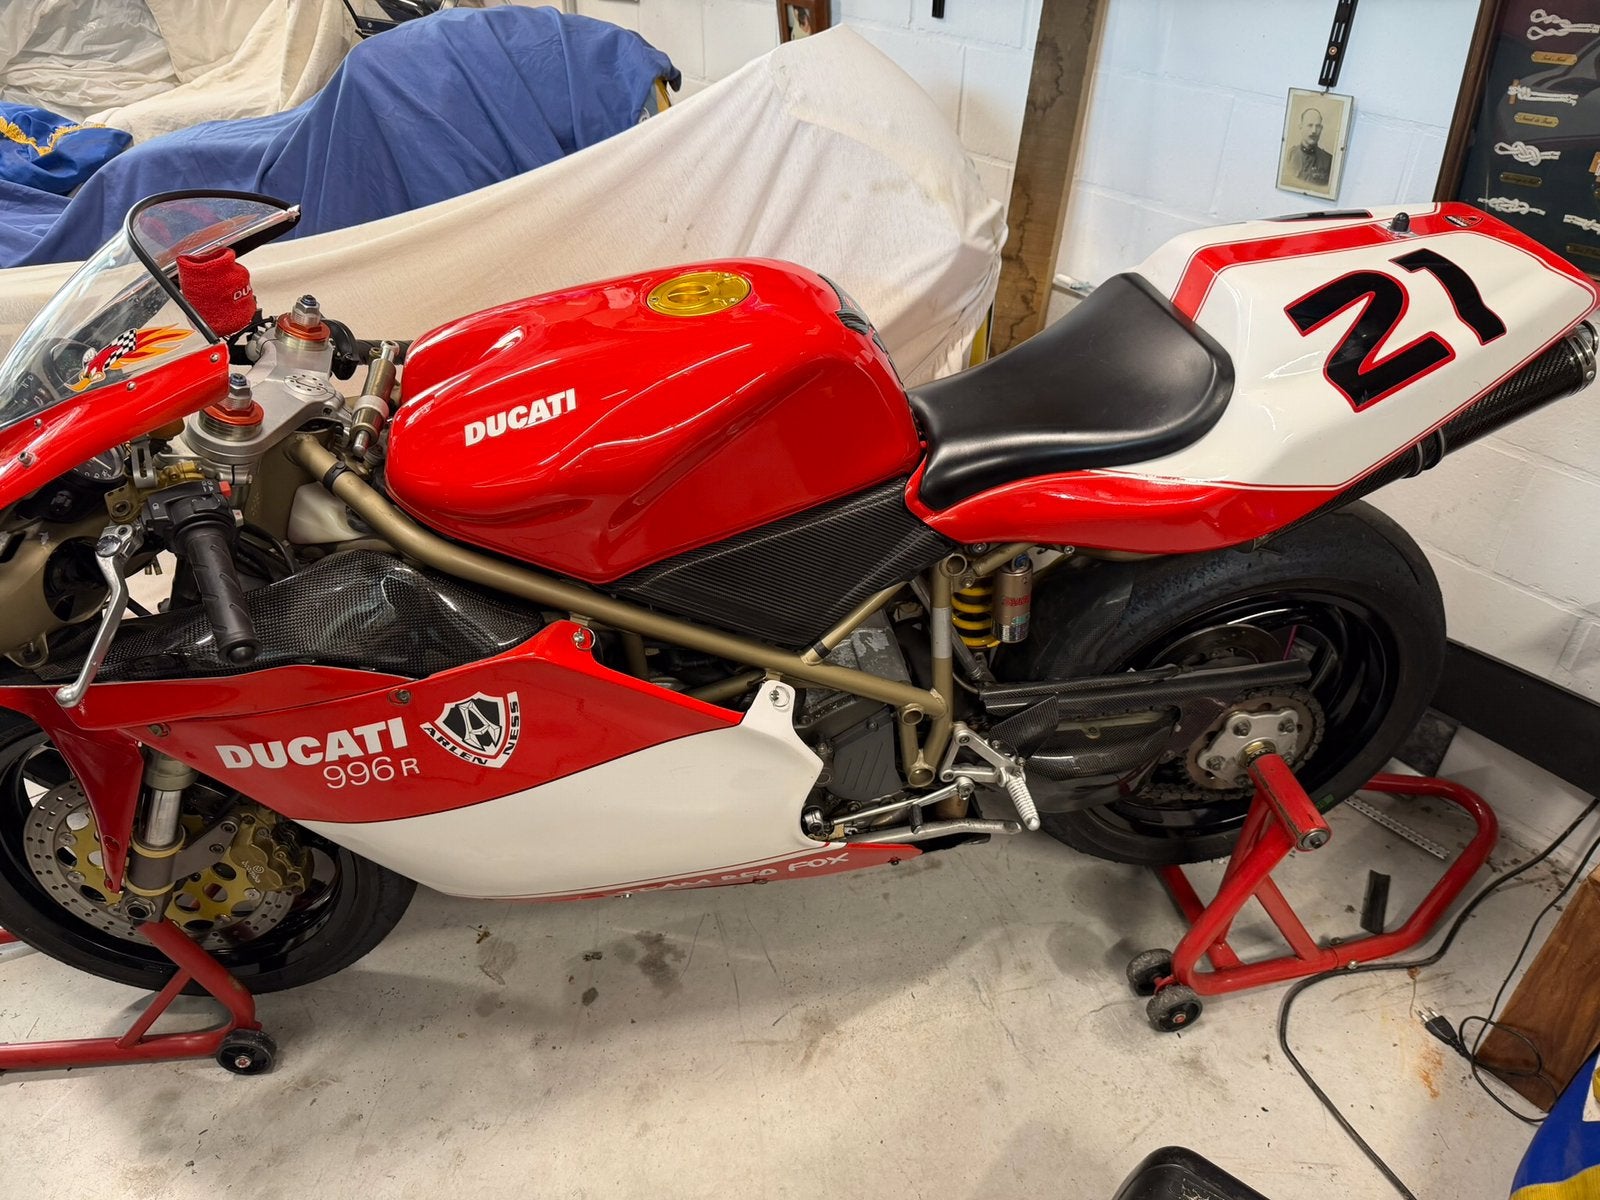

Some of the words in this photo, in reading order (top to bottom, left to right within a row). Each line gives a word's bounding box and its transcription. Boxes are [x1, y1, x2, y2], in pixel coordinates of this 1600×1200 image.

[464, 388, 576, 447] DUCATI
[215, 717, 408, 769] DUCATI
[423, 726, 489, 766] ARLEN
[502, 701, 520, 756] NESS
[323, 756, 395, 789] 996
[400, 758, 421, 777] R
[788, 852, 849, 872] FOX
